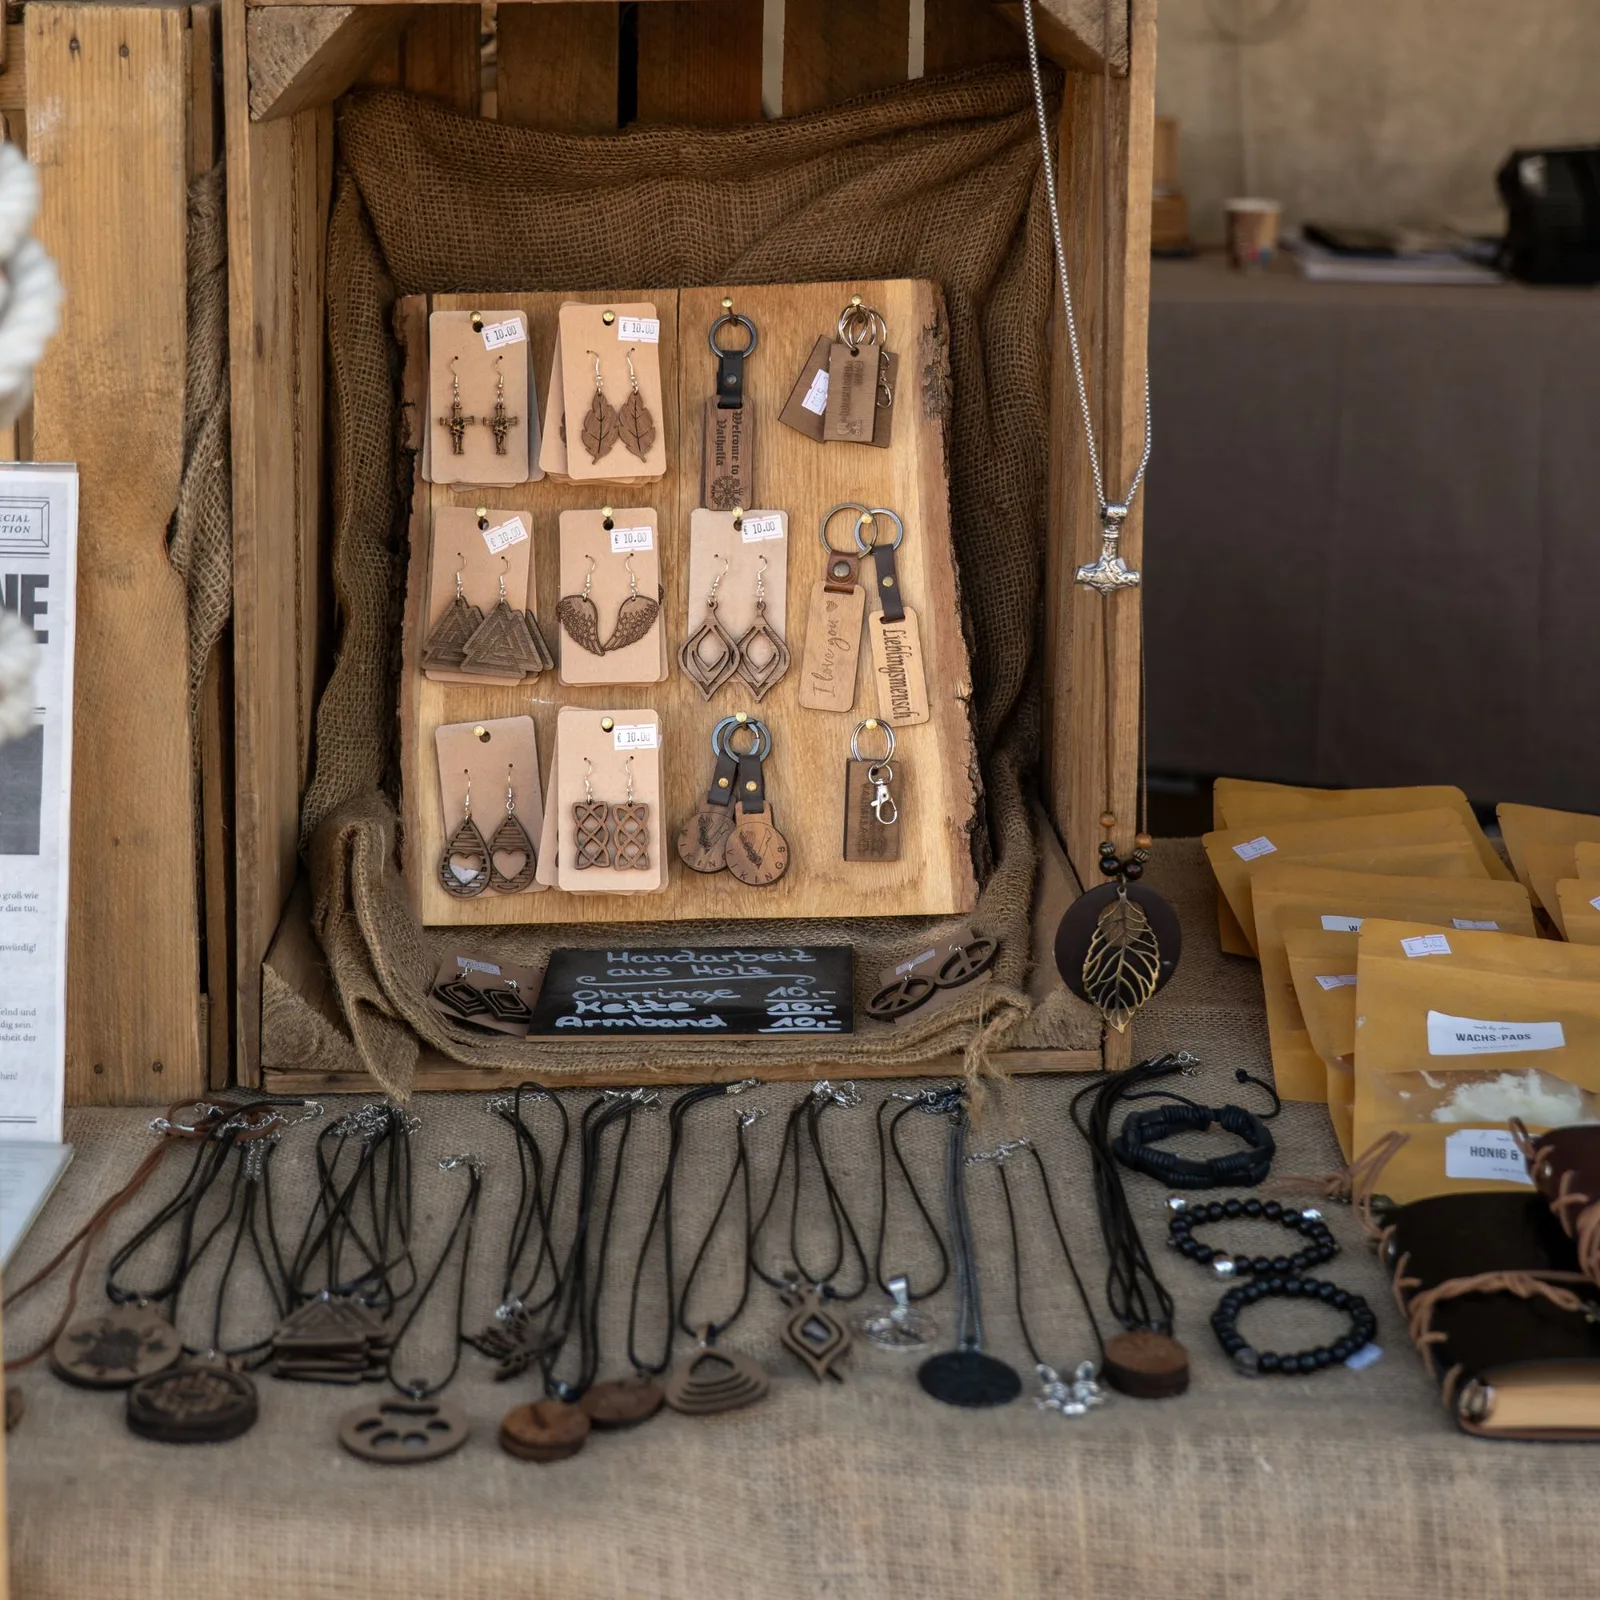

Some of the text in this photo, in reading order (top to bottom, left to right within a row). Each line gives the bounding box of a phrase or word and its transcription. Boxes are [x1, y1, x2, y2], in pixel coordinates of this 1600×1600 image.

[494, 325, 518, 341] 10.00
[632, 323, 655, 335] 10.00
[716, 419, 727, 466] Valhalla
[731, 410, 743, 475] Welcome to
[0, 526, 31, 534] TION
[752, 521, 776, 534] 10.00
[499, 526, 522, 545] 10.00
[623, 532, 647, 545] 10.00
[811, 619, 851, 698] I love you
[878, 629, 920, 720] Lieblingsmensch
[627, 732, 651, 743] 10.00
[727, 846, 786, 884] VIKINGS
[24, 891, 39, 900] wie
[5, 904, 22, 912] dies
[607, 949, 816, 964] Handarbeit
[607, 964, 773, 978] aus Holz
[572, 988, 741, 1004] Ohrringe
[0, 1008, 36, 1016] elnd und
[575, 999, 696, 1014] Kette
[555, 1014, 728, 1028] Armband
[1455, 1033, 1532, 1042] WACHS-PADS
[1470, 1146, 1519, 1161] HONIG &
